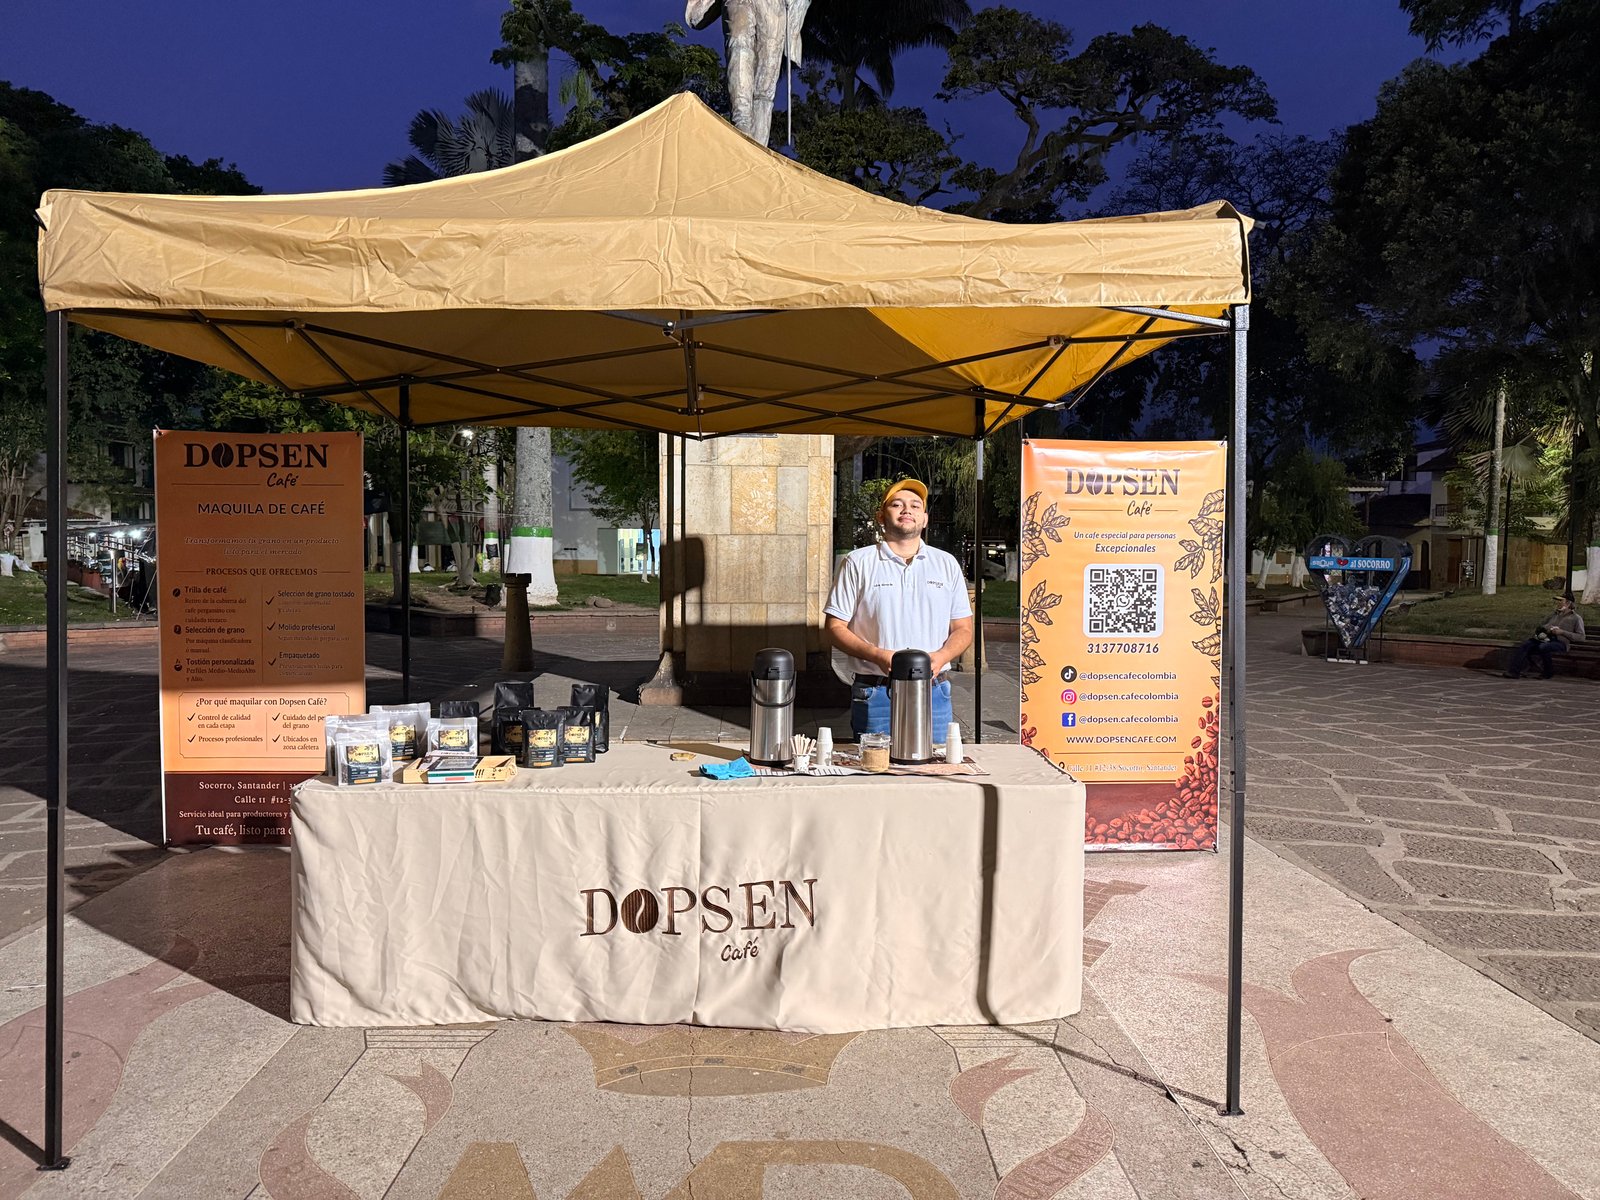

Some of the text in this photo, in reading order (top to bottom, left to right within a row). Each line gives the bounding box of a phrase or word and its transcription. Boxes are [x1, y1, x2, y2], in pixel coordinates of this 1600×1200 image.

[183, 442, 329, 468] DOPSEN
[266, 472, 300, 488] Café
[1064, 467, 1181, 496] DOPSEN
[198, 500, 326, 517] MAQUILA DE CAFÉ
[1126, 500, 1153, 517] Café
[1074, 531, 1084, 539] Un
[1101, 531, 1128, 540] especial
[1129, 532, 1145, 540] para
[1145, 532, 1176, 540] personas
[305, 537, 339, 547] producto
[1095, 543, 1156, 554] Excepcionales
[1357, 560, 1391, 569] SOCORRO
[205, 567, 318, 577] PROCESOS QUE OFRECEMOS
[184, 585, 227, 594] Trilla de café
[306, 590, 313, 598] de
[314, 591, 333, 600] grano
[333, 590, 355, 598] tostado
[185, 626, 245, 636] Selección de grano
[278, 623, 336, 633] Molido profesional
[1087, 643, 1159, 654] 3137708716
[279, 651, 320, 661] Empaquetado
[211, 658, 255, 667] personalizada
[1079, 692, 1179, 702] @dopsen.cafecolombia
[195, 697, 328, 708] ¿Por qué maquilar con Dopsen Café?
[197, 713, 251, 722] Control de calidad
[282, 713, 307, 721] Cuidado
[307, 713, 317, 721] del
[1079, 714, 1179, 725] @dopsen.cafecolombia
[219, 722, 235, 731] etapa
[282, 721, 310, 731] del grano
[198, 735, 264, 744] Procesos profesionales
[282, 735, 309, 743] Ubicados
[1066, 735, 1177, 744] WWW.DOPSENCAFE.COM
[297, 743, 320, 751] cafetera
[1066, 764, 1083, 772] Calle
[199, 781, 235, 791] Socorro,
[237, 781, 280, 790] Santander
[234, 795, 256, 804] Calle
[179, 810, 206, 818] Servicio
[207, 810, 225, 818] ideal
[225, 811, 241, 819] para
[242, 810, 282, 819] productores
[195, 824, 210, 835] Tu
[212, 823, 237, 837] café,
[239, 824, 261, 835] listo
[263, 826, 286, 838] para
[579, 878, 818, 937] DOPSEN
[720, 936, 759, 962] Café
